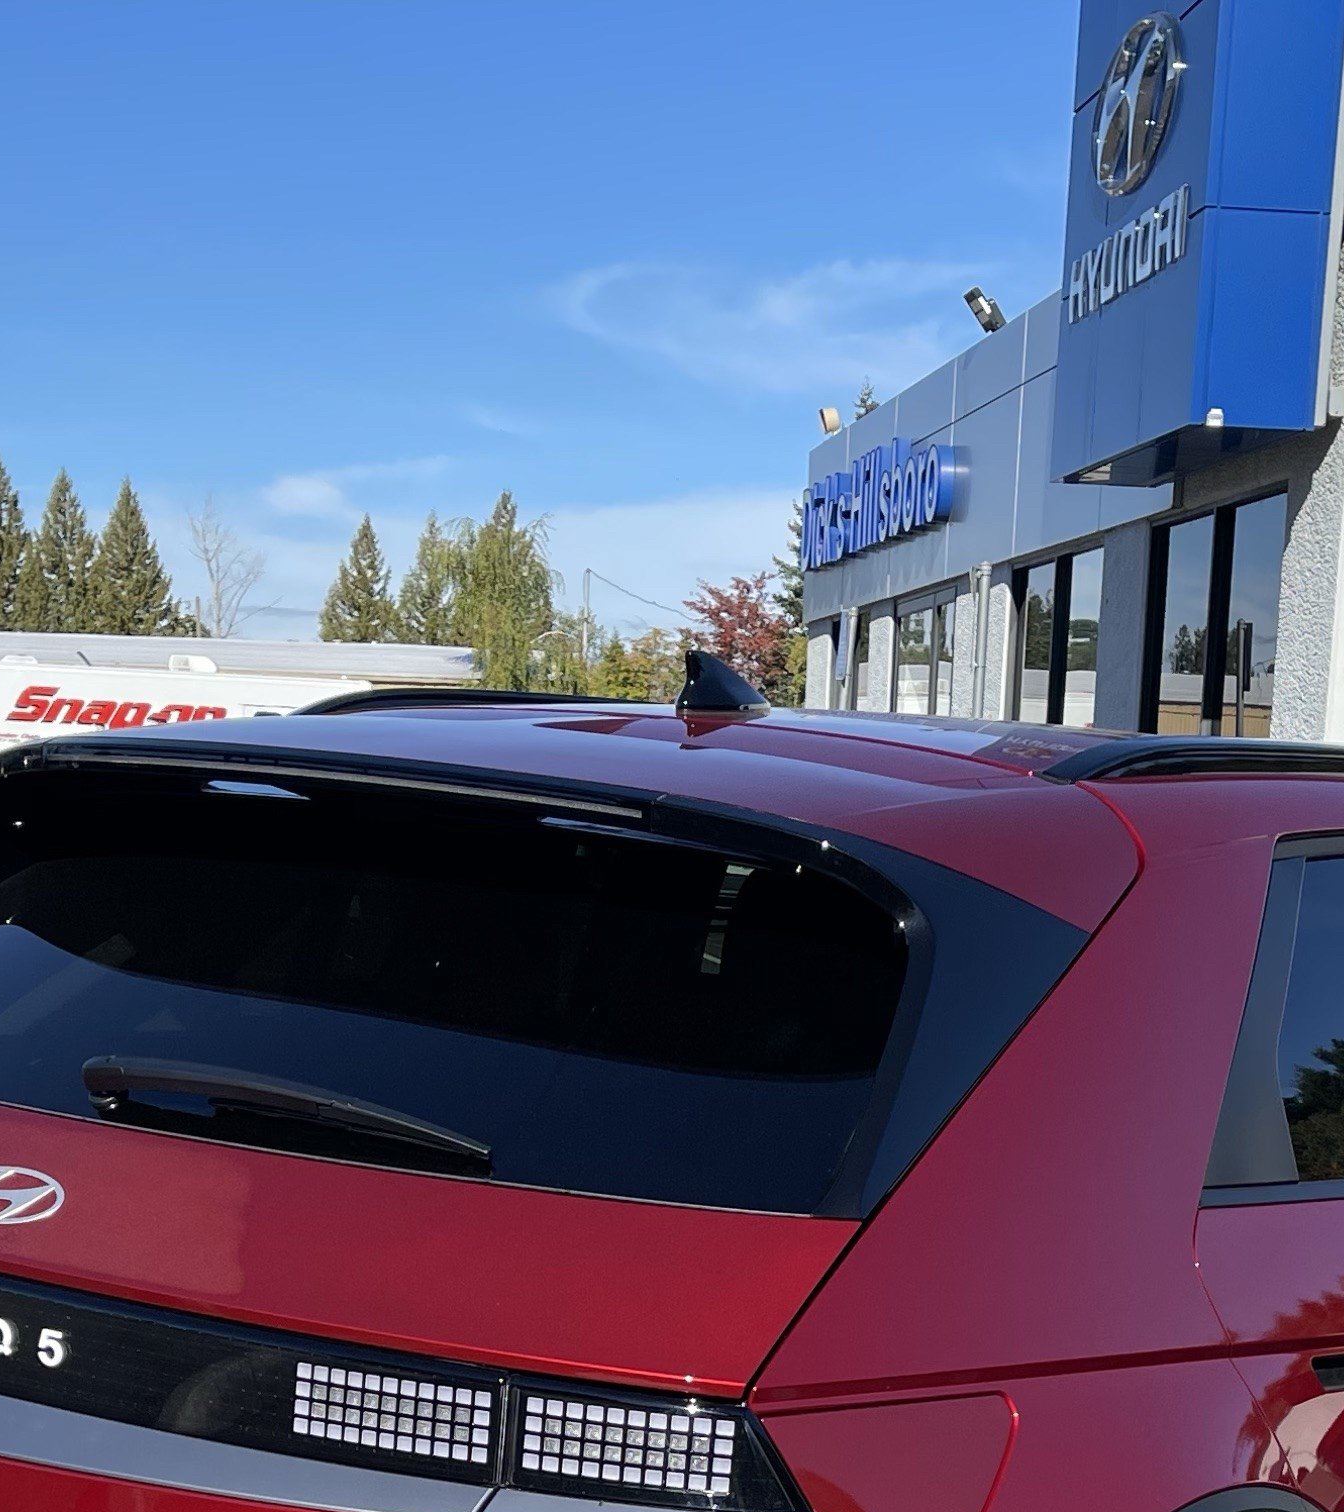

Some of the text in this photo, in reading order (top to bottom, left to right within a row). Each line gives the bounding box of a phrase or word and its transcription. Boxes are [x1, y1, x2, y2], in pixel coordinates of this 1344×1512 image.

[1068, 183, 1190, 324] HYUNDAI
[800, 437, 942, 573] Dick's Hillsboro
[6, 685, 227, 730] Snap-on
[36, 1327, 70, 1369] 5
